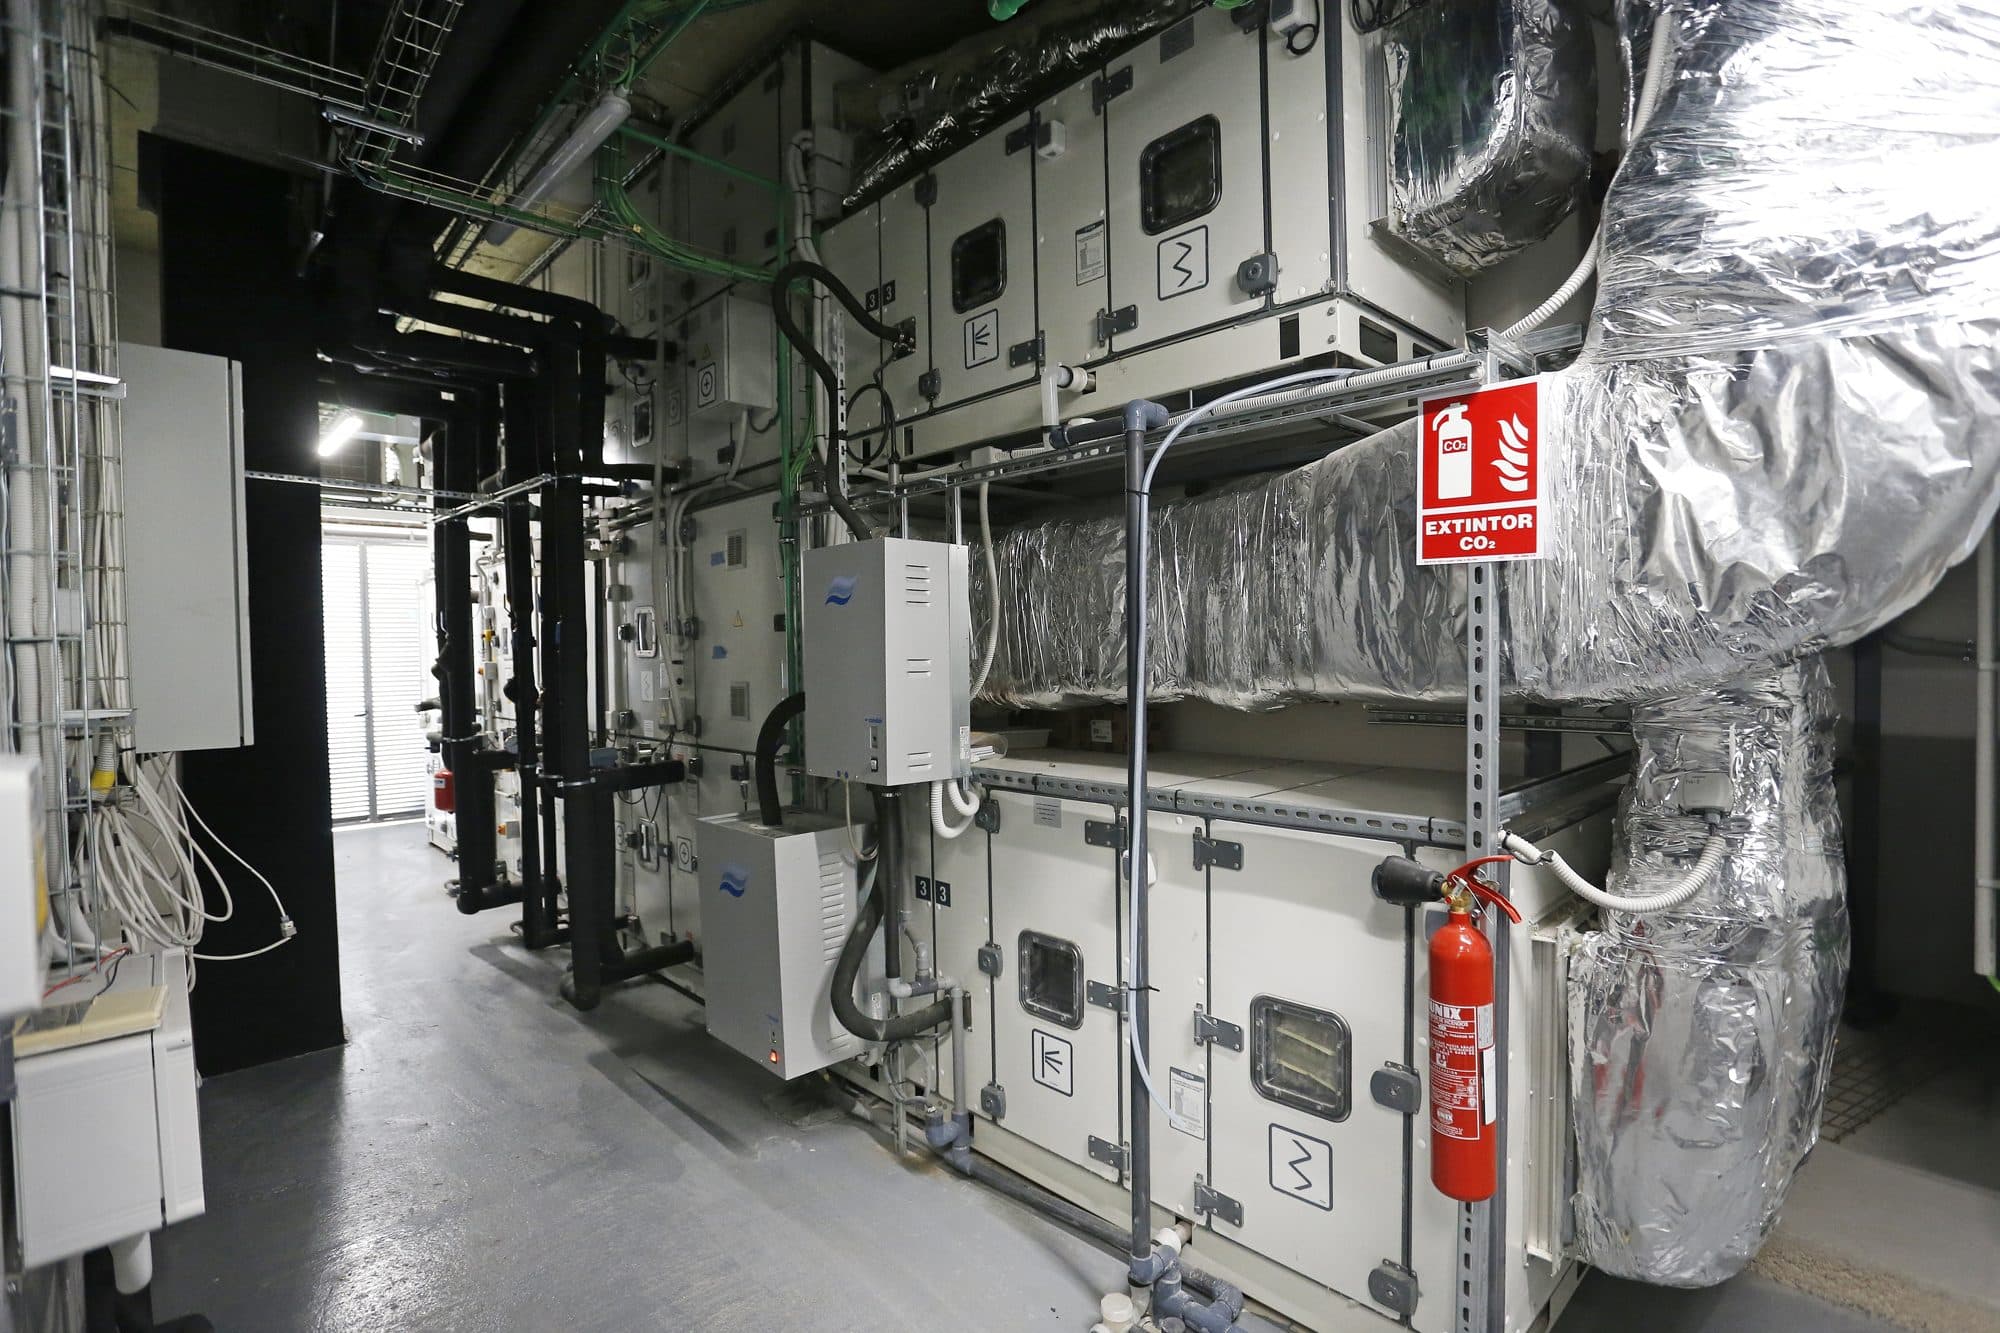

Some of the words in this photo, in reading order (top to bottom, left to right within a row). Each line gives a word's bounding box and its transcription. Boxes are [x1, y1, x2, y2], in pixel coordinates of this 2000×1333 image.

[870, 294, 876, 308] 3
[886, 286, 892, 300] 3
[1425, 513, 1533, 536] EXTINTOR
[920, 880, 927, 896] 3
[940, 886, 947, 902] 3
[1429, 1000, 1461, 1020] UNIX
